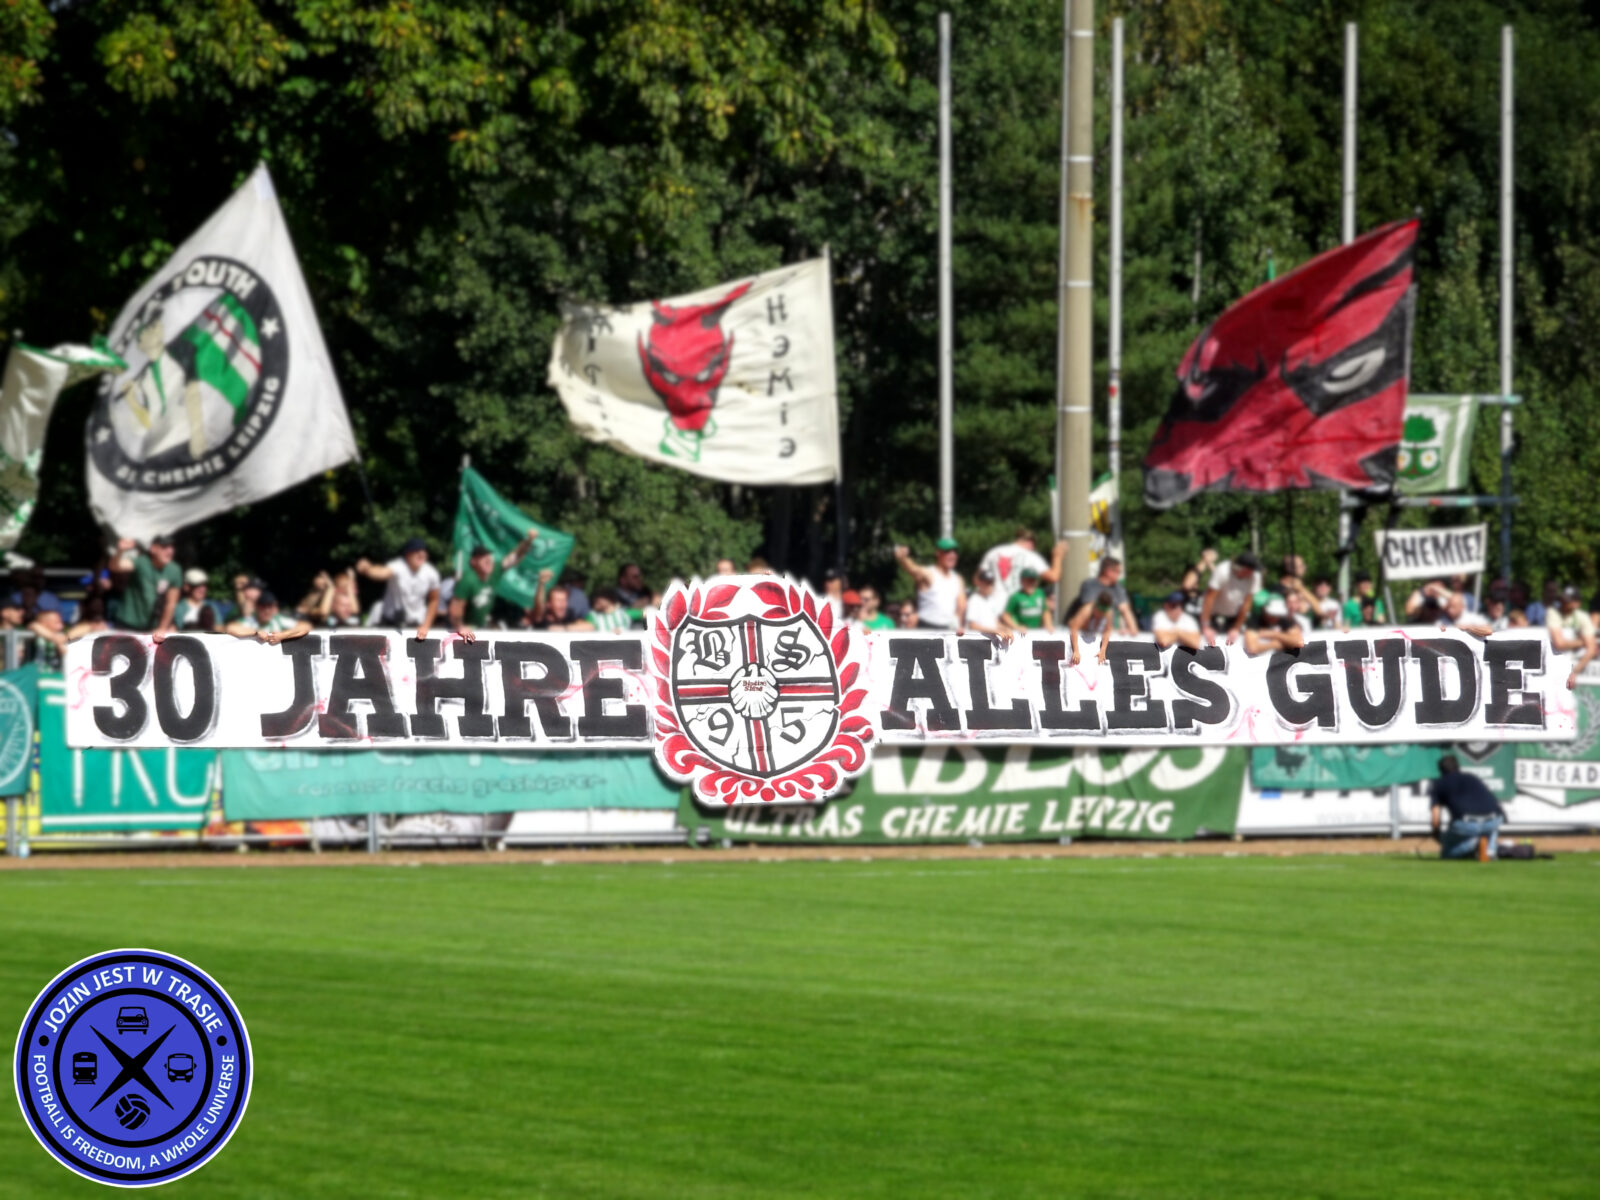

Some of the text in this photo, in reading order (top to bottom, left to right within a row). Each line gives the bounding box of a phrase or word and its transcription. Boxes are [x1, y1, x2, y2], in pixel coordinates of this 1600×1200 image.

[142, 456, 226, 486] CHEMIE
[91, 634, 650, 743] 30 JAHRE
[879, 638, 1545, 733] ALLES GUDE
[723, 796, 1175, 838] ULTRAS CHEMIE LEIPZIG
